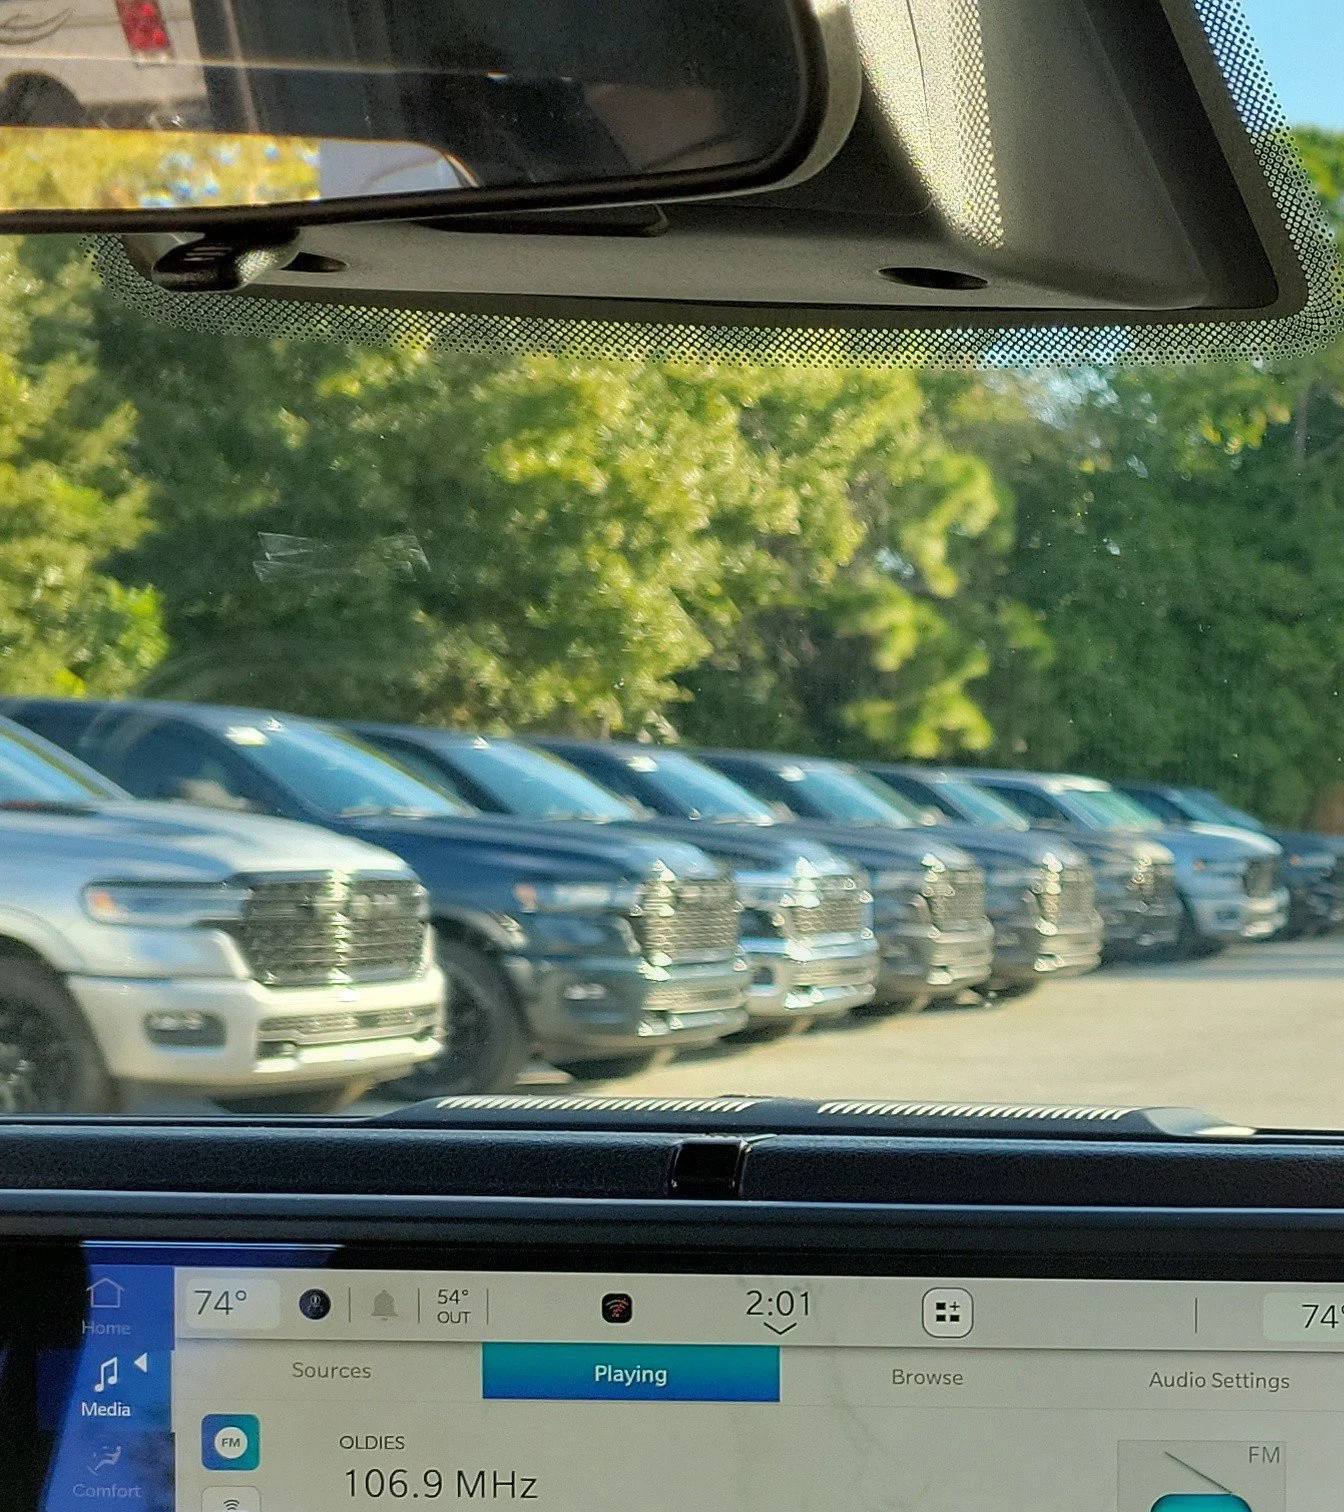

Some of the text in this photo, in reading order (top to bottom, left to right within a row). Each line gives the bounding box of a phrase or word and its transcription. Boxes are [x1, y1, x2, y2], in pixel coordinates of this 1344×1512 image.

[194, 1290, 247, 1316] 74°
[437, 1289, 469, 1305] 54°
[745, 1291, 811, 1317] 2:01
[437, 1311, 471, 1324] OUT
[81, 1320, 131, 1335] Home
[292, 1361, 372, 1379] Sources
[594, 1362, 668, 1387] Playing
[891, 1368, 964, 1387] Browse
[1148, 1371, 1291, 1395] Audio Settings
[81, 1401, 131, 1417] Media
[221, 1437, 241, 1448] FM
[339, 1435, 405, 1450] OLDIES
[1248, 1447, 1281, 1464] FM
[72, 1483, 142, 1499] Comfort
[345, 1468, 539, 1499] 106.9 MHz
